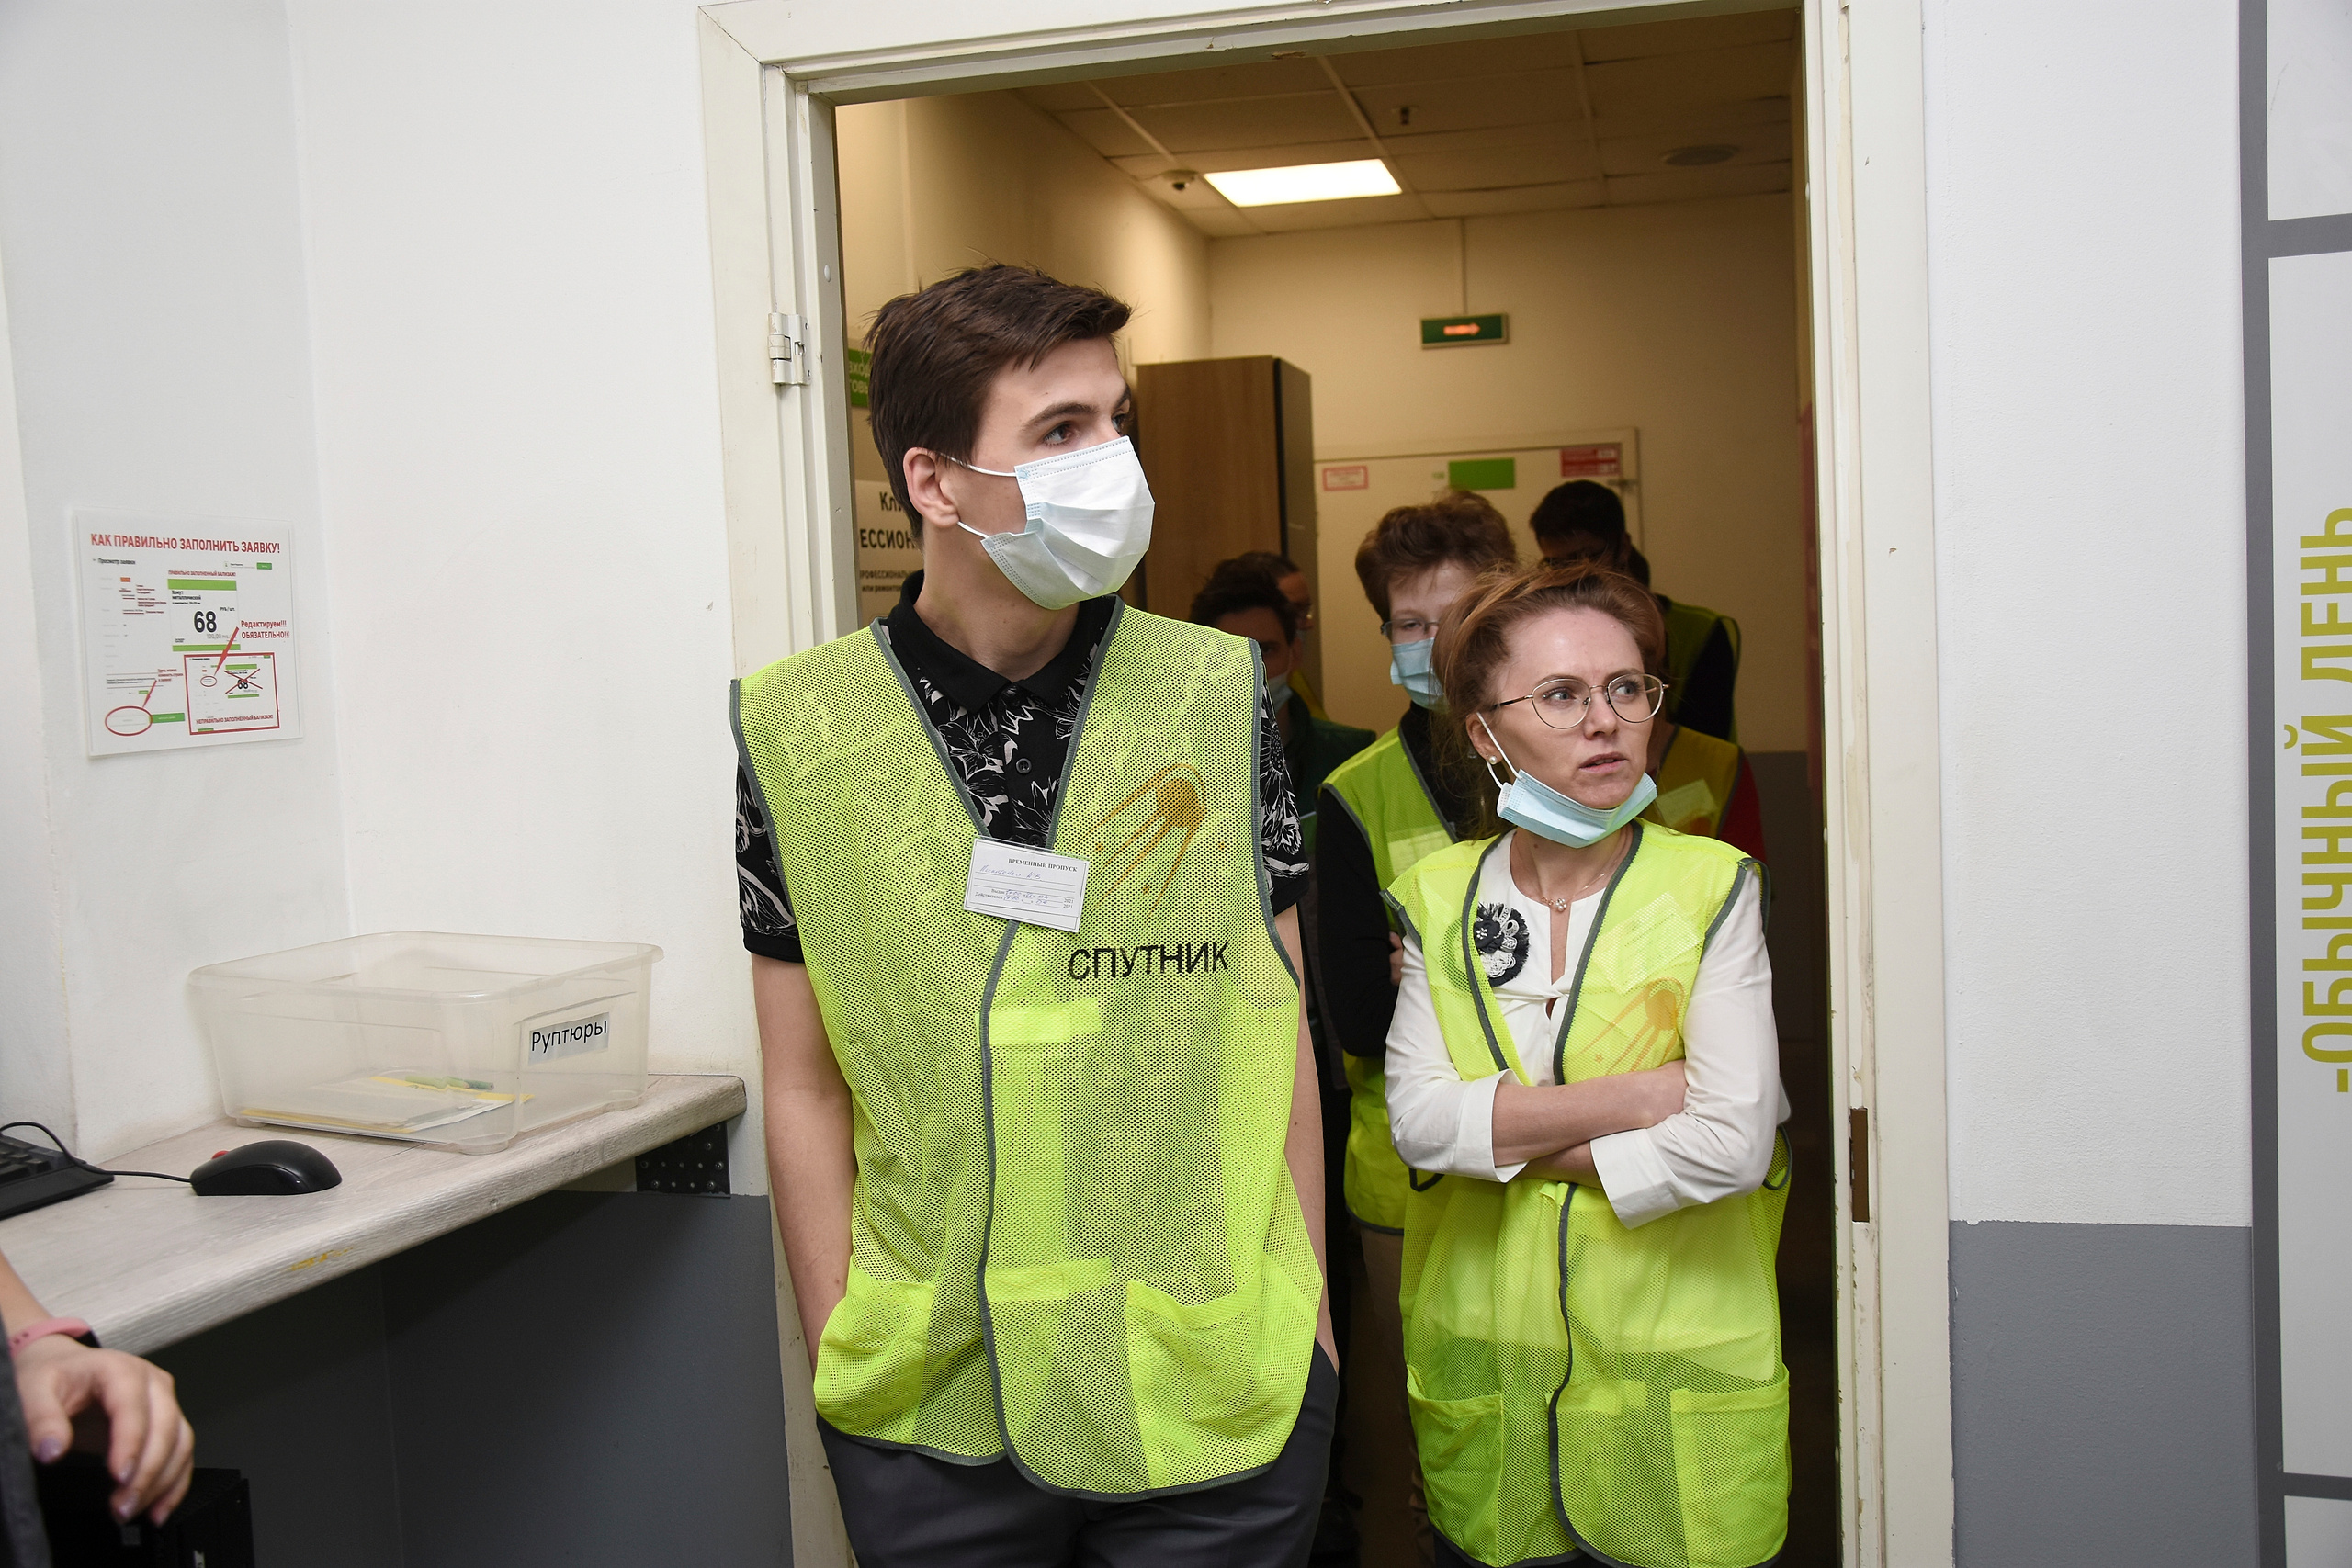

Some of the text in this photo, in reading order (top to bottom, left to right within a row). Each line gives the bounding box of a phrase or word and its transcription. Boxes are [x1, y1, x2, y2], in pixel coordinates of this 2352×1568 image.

[91, 533, 280, 554] КАК ПРАВИЛЬНО ЗАПОЛНИТЬ ЗАЯВКУ!
[194, 610, 217, 633] 68
[241, 620, 287, 629] Редактируем!!!
[1008, 858, 1078, 872] ВРЕМЕННЫЙ ПРОПУСК
[1068, 942, 1229, 980] СПУТНИК
[531, 1020, 607, 1054] Руптюры
